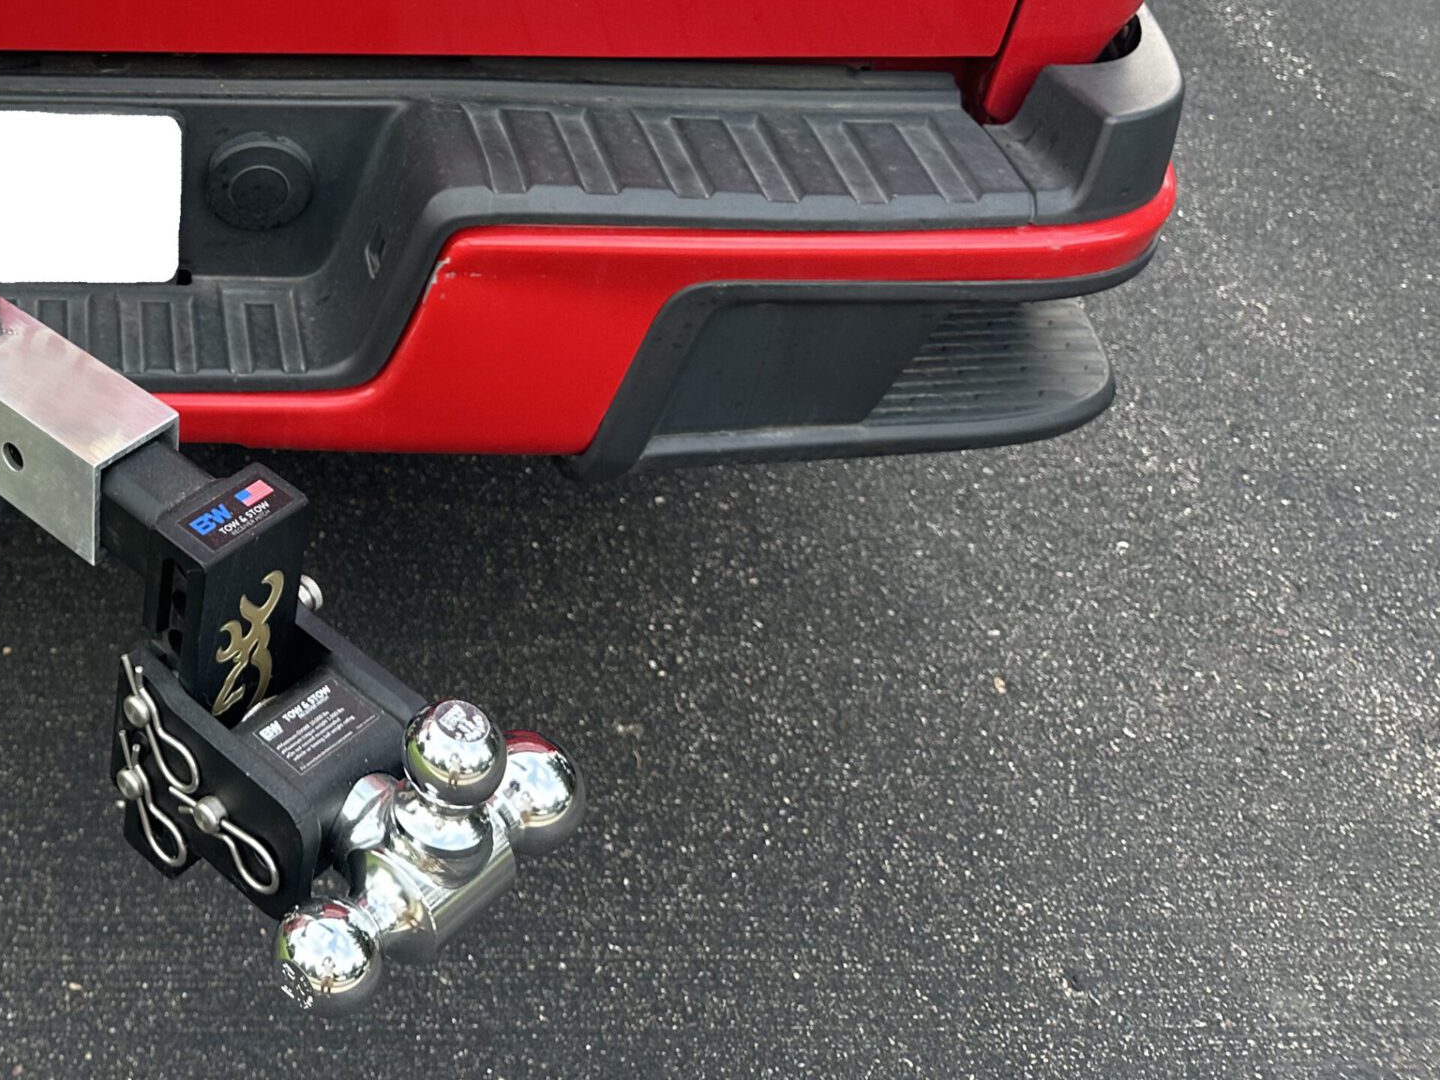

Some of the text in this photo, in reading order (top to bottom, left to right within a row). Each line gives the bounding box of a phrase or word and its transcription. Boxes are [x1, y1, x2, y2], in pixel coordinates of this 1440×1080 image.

[219, 501, 270, 535] TOW & STOW
[282, 704, 303, 722] TOW
